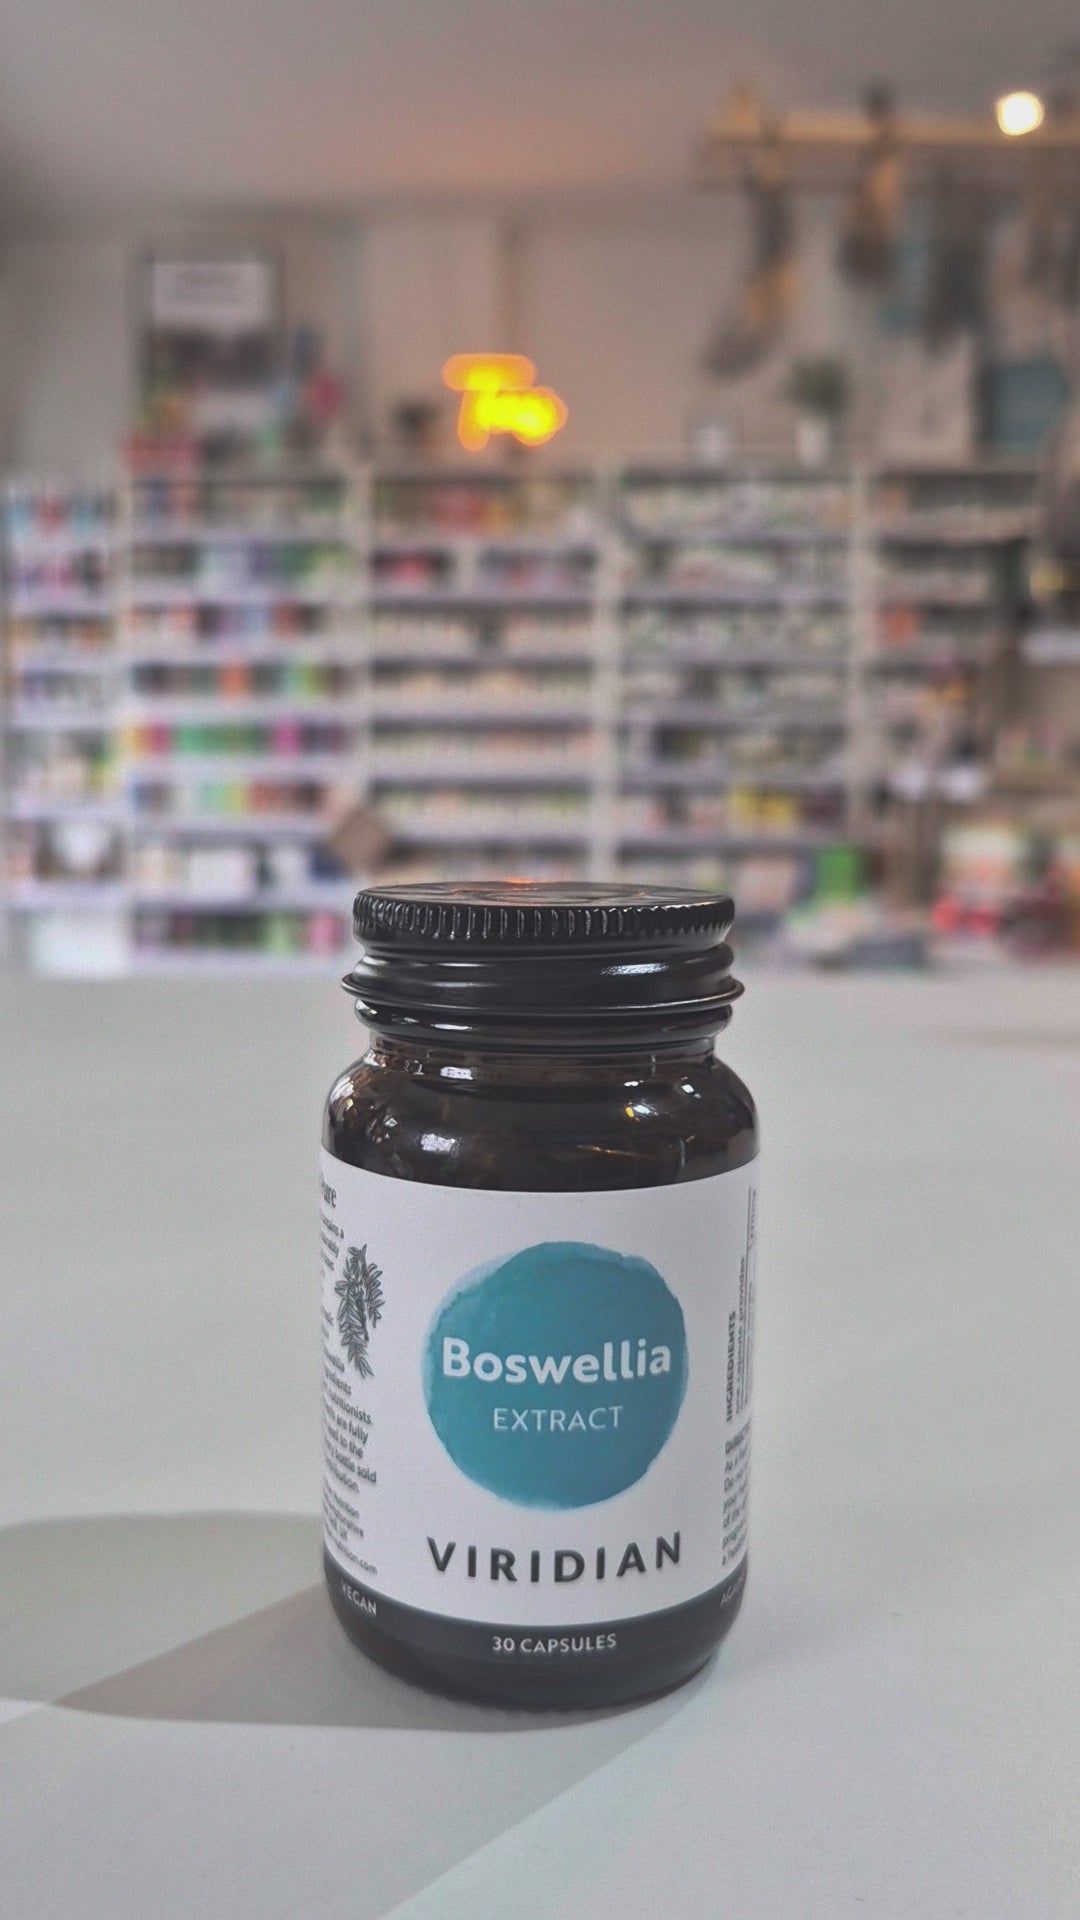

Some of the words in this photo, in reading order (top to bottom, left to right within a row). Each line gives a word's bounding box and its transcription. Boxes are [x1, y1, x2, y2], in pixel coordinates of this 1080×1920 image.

[442, 1336, 671, 1385] Boswellia
[726, 1311, 736, 1422] INGREDIENTS
[493, 1405, 624, 1432] EXTRACT
[348, 1420, 369, 1445] fully
[349, 1440, 363, 1459] the
[357, 1465, 377, 1484] sold
[427, 1531, 681, 1583] VIRIDIAN
[340, 1578, 378, 1615] VEGAN
[492, 1635, 515, 1652] 30
[520, 1632, 618, 1653] CAPSULES
